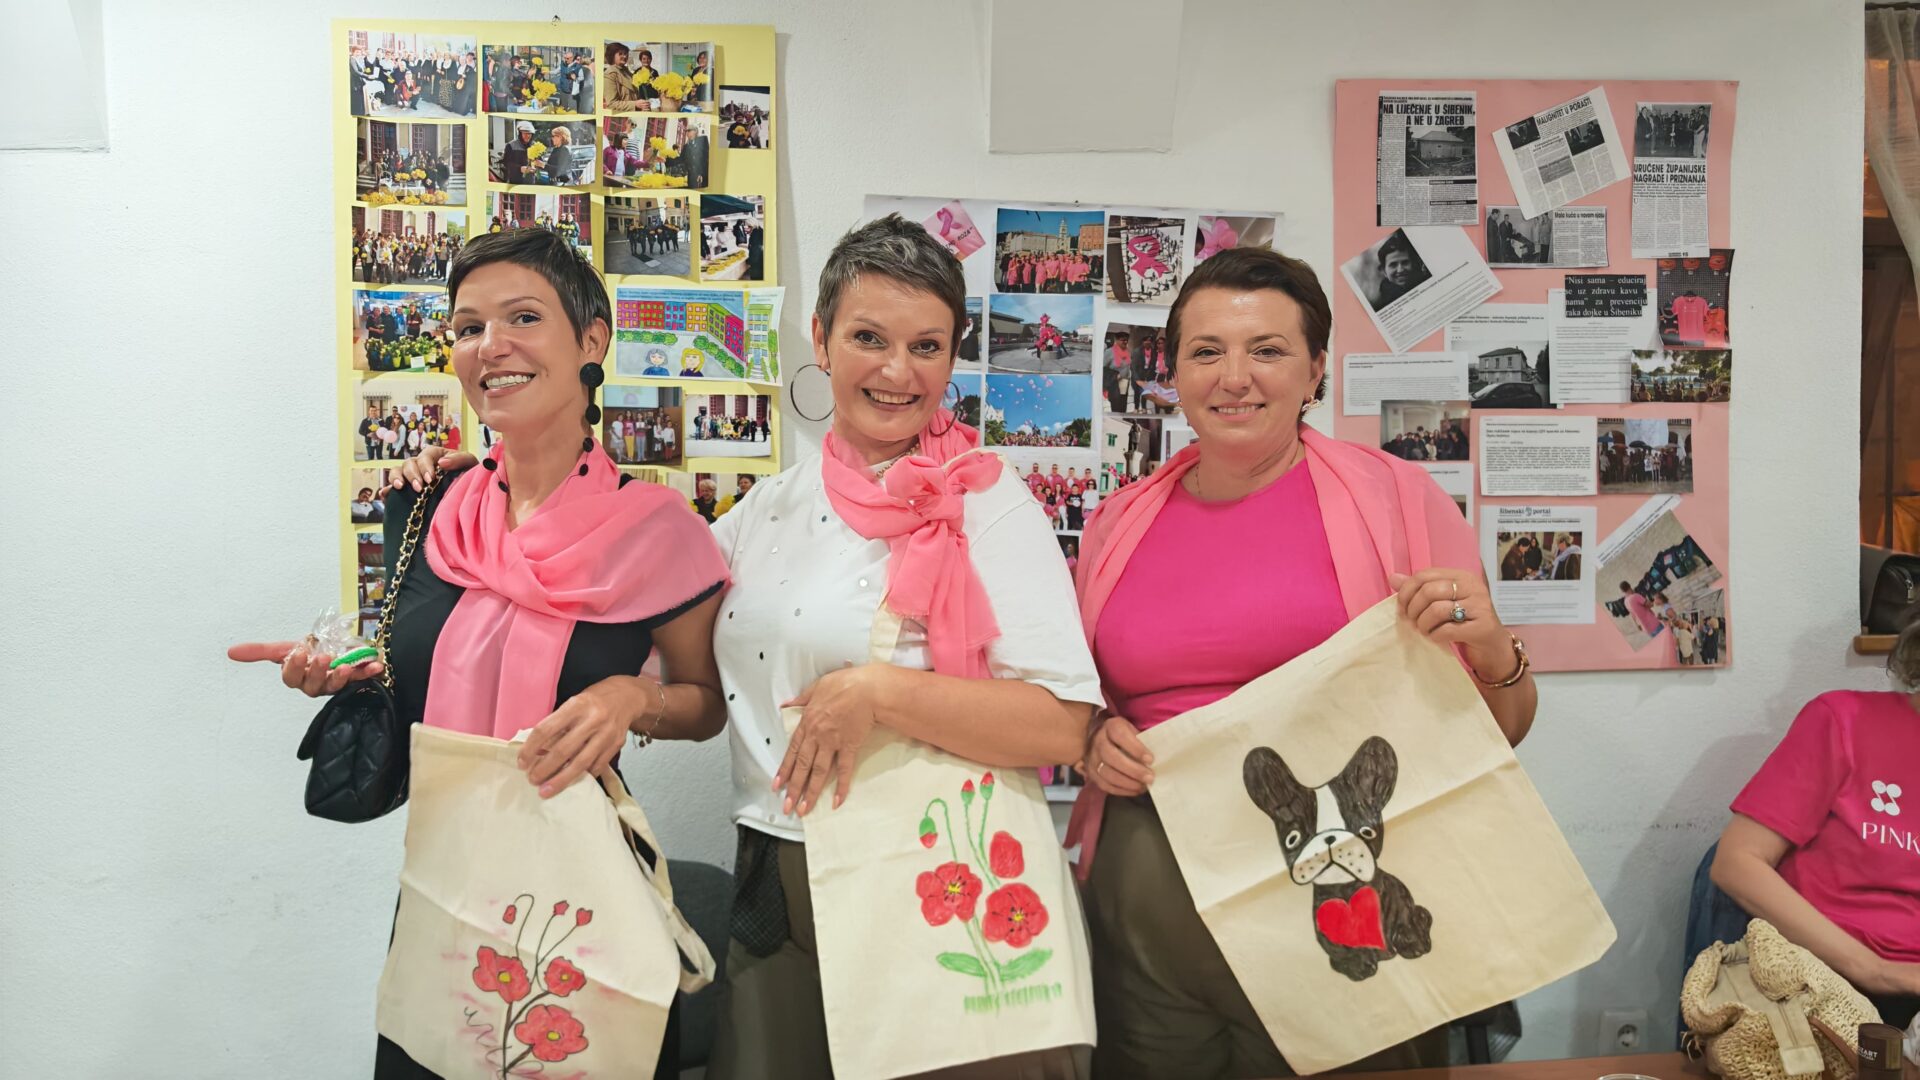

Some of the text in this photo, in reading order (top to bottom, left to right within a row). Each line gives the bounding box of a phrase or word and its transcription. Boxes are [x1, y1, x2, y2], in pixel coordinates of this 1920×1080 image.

[1383, 104, 1394, 114] NA
[1434, 104, 1440, 114] U
[1406, 116, 1465, 126] A NE U ZAGREB
[1634, 174, 1664, 182] NAGRADE
[1670, 174, 1706, 183] PRIZNANJA
[1582, 309, 1602, 317] dojke
